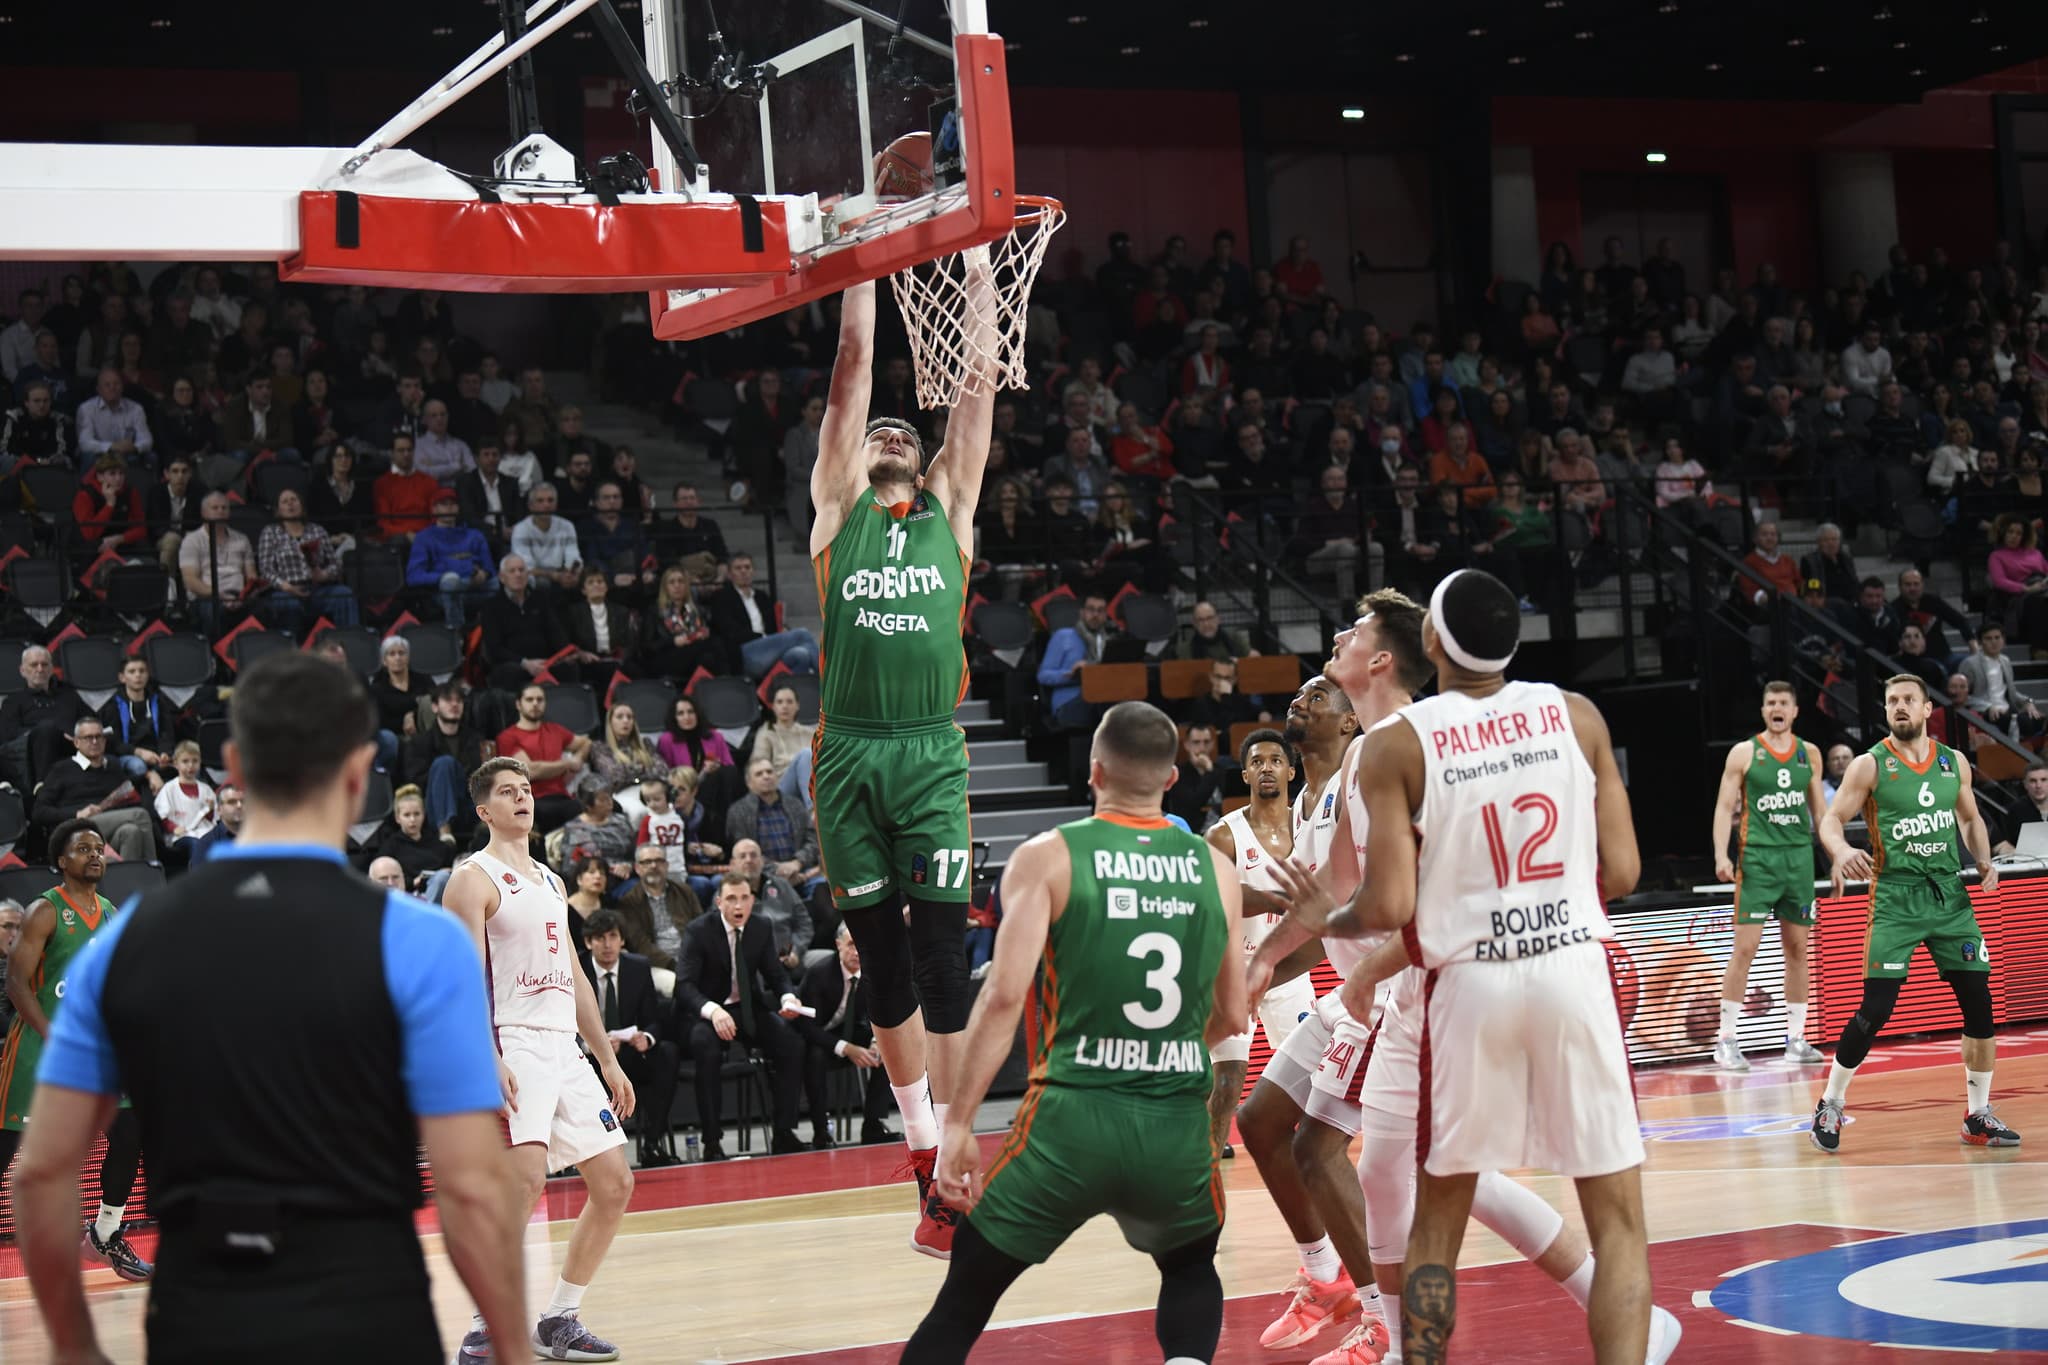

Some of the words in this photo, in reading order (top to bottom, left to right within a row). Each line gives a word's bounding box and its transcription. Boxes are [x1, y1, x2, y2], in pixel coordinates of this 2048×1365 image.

[842, 565, 946, 601] CEDEVITA
[854, 607, 930, 636] ARGETA
[1432, 711, 1533, 760] PALMER
[1538, 704, 1566, 736] JR
[1443, 760, 1509, 786] Charles
[1777, 768, 1792, 788] 8
[1757, 790, 1806, 812] CEDEVITA
[1918, 781, 1936, 808] 6
[1767, 812, 1801, 826] ARGETA
[1892, 808, 1955, 841] CEDEVITA
[1481, 792, 1565, 889] 12
[932, 848, 969, 889] 17
[1093, 849, 1203, 885] RADOVIĆ
[1140, 895, 1197, 919] triglav
[1490, 898, 1570, 938] BOURG
[545, 922, 559, 954] 5
[1475, 940, 1507, 961] EN
[1122, 931, 1183, 1030] 3
